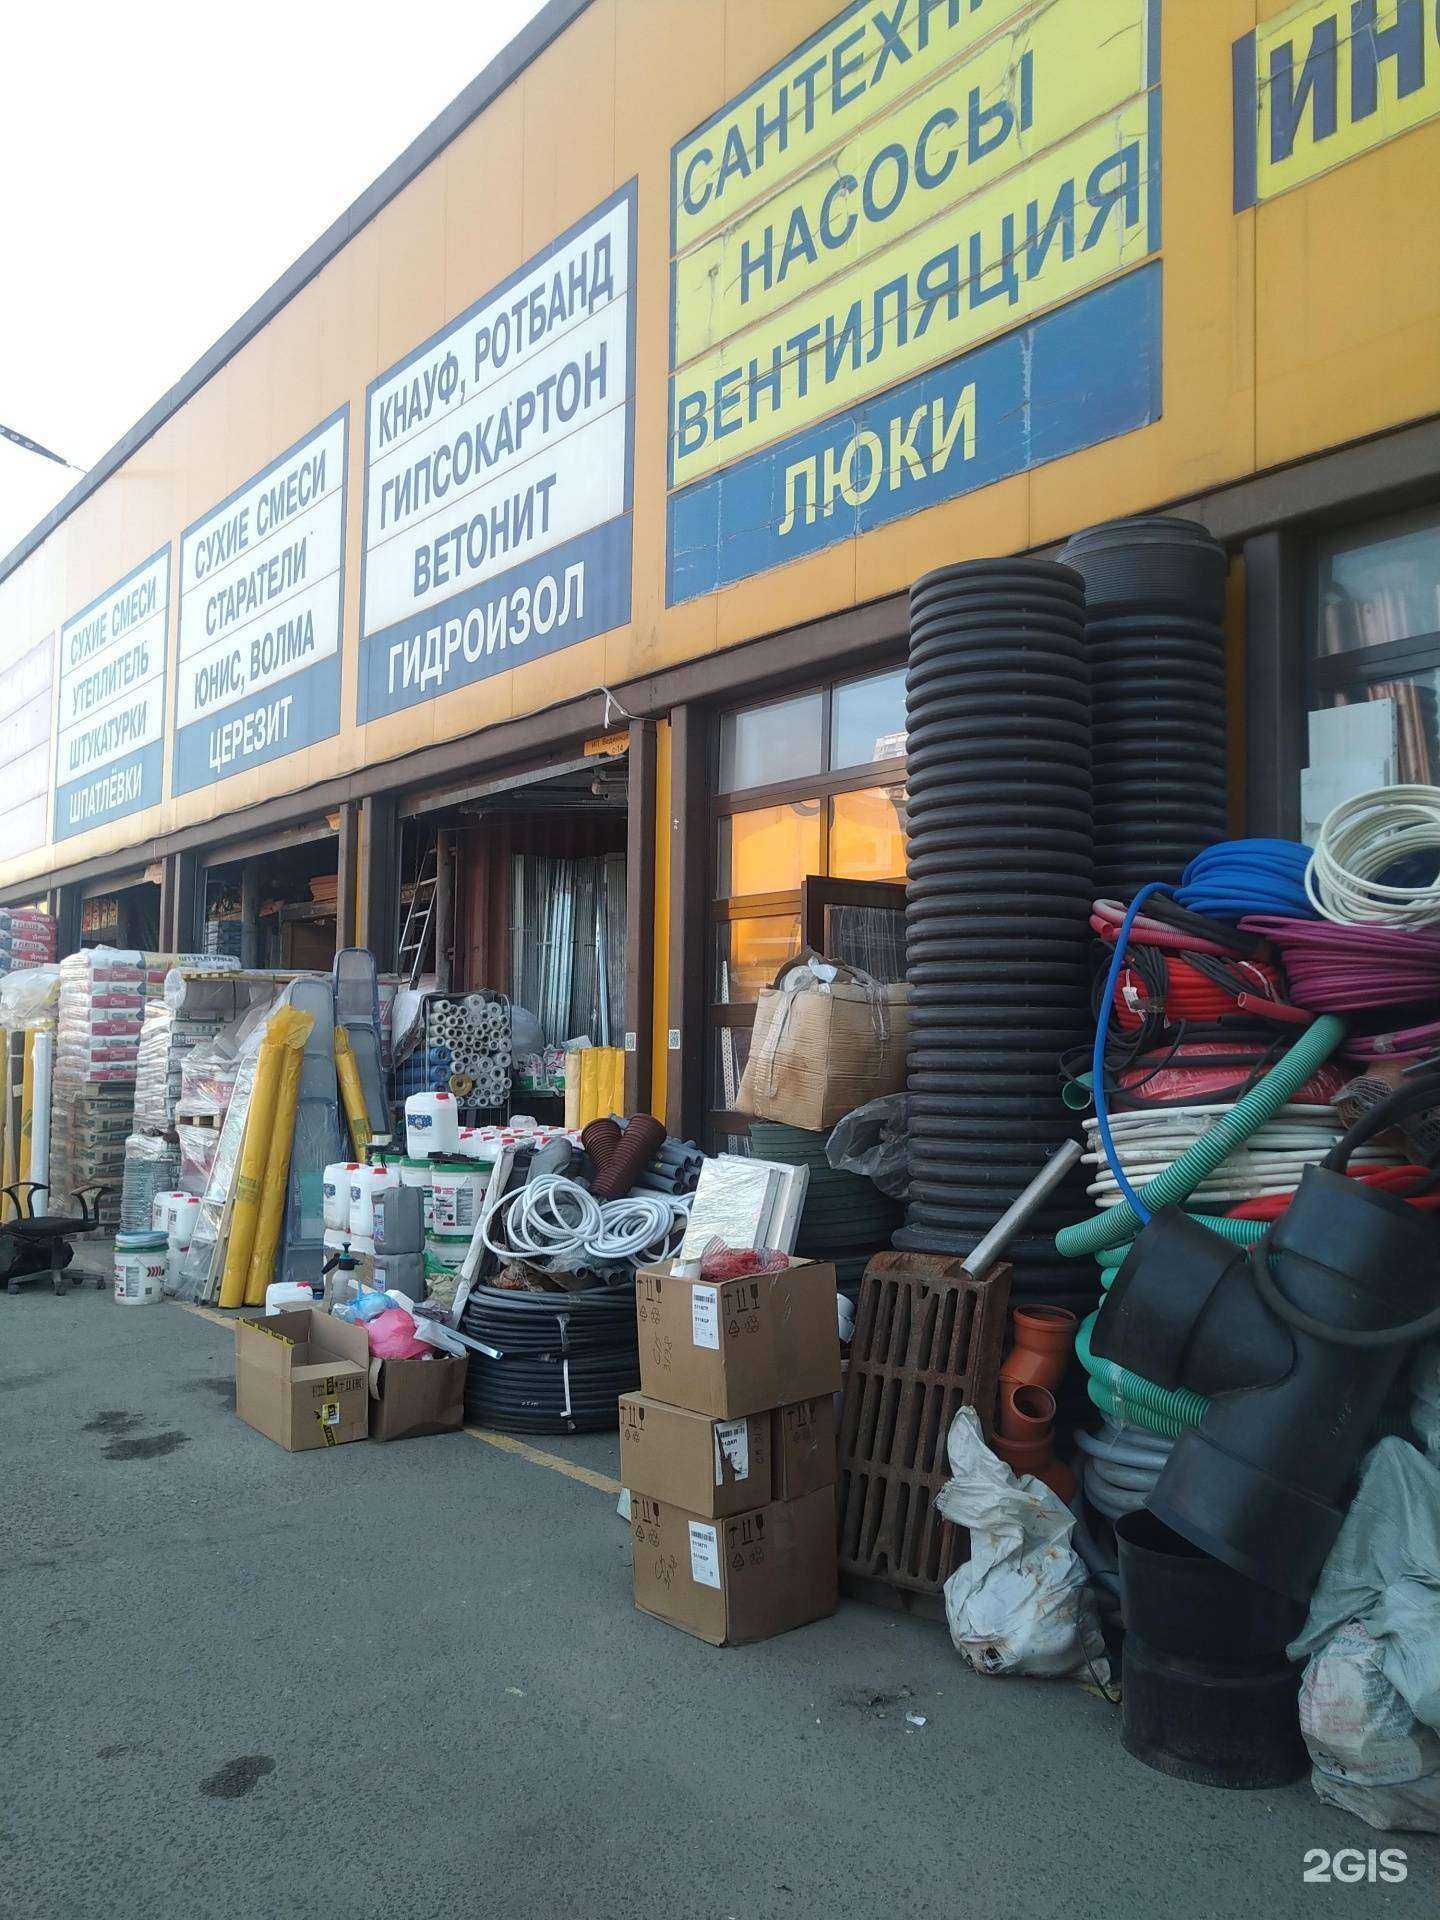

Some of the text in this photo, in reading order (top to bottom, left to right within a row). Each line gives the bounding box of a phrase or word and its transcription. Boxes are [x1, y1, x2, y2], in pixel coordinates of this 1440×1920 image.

[682, 0, 982, 215] САНТЕХН
[1269, 0, 1440, 165] ИН
[741, 49, 1034, 305] НАСОСЫ
[379, 232, 613, 447] КНАУФ, РОТБАНД
[678, 140, 1140, 459] ВЕНТИЛЯЦИЯ
[381, 341, 607, 530] ГИПСОКАРТОН
[777, 384, 976, 535] ЛЮКИ
[195, 448, 326, 579] СУХИЕ СМЕСИ
[413, 473, 557, 597] ВЕТОНИТ
[70, 576, 156, 665] СУХИЕ СМЕСИ
[206, 537, 306, 636] СТАРАТЕЛИ
[388, 561, 584, 695] ГИДРОИЗОЛ
[72, 647, 149, 715] УТЕПЛИТЕЛЬ
[194, 609, 315, 709] ЮНИС, ВОЛМА
[69, 763, 142, 824] ШПАТЛЁВКИ
[70, 700, 147, 771] ШТУКАТУРКИ
[209, 695, 293, 773] ЦЕРЕЗИТ
